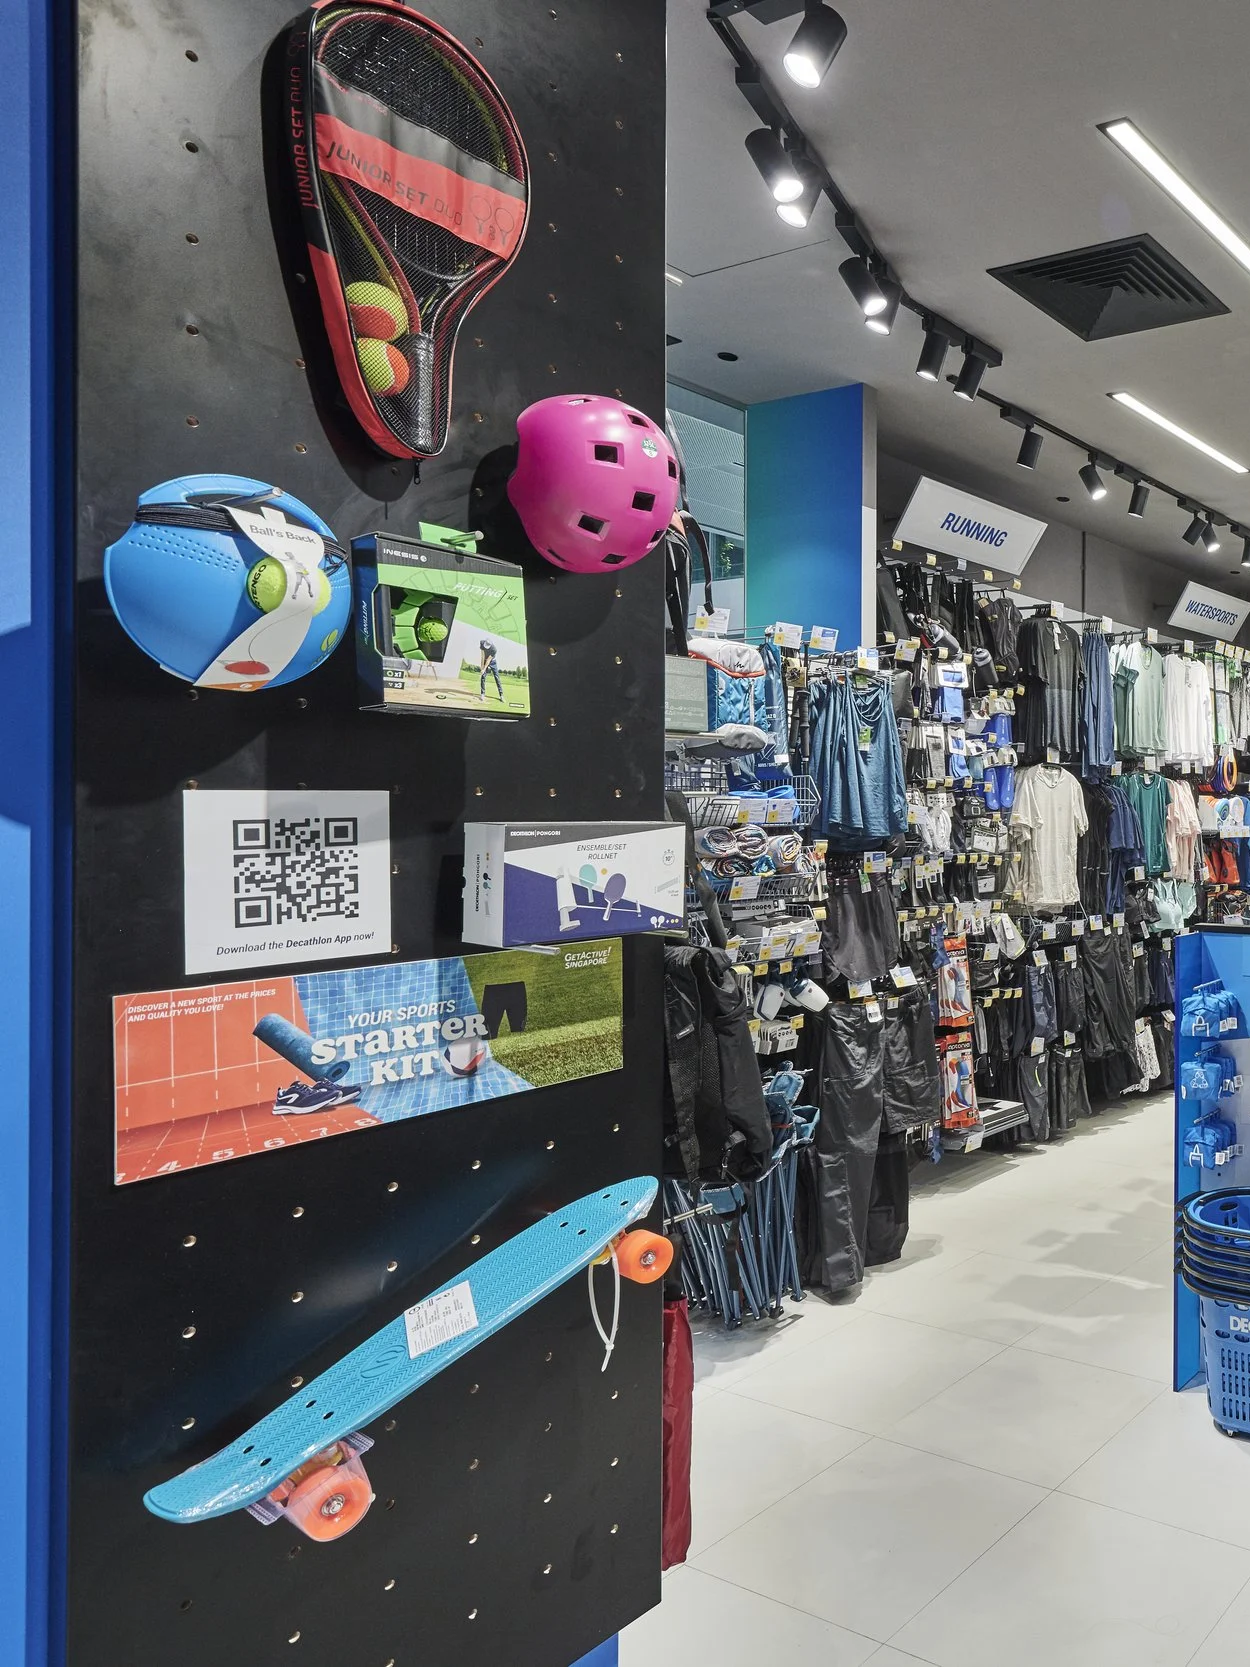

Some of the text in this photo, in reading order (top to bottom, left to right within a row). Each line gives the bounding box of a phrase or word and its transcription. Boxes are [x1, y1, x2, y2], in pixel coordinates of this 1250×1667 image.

[290, 106, 306, 138] SET
[294, 144, 320, 209] JUNIOR
[326, 141, 463, 226] JUNIOR SET DUO
[250, 524, 317, 544] Ball's Back
[939, 511, 1008, 549] RUNNING
[383, 548, 419, 560] INESIS
[453, 582, 505, 598] PUTTING
[1184, 599, 1239, 626] WATERSPORTS
[576, 842, 627, 852] ENSEMBLE/SET
[587, 852, 618, 860] ROLLNET
[216, 931, 375, 956] Download the Decathlon App now!
[564, 957, 608, 970] SINGAPORE
[127, 1003, 169, 1015] DISCOVER
[177, 999, 197, 1008] NEW
[197, 995, 223, 1005] SPORT
[234, 992, 249, 1000] THE
[250, 988, 277, 999] PRICES
[127, 1004, 224, 1023] AND QUALITY YOU LOVE!
[346, 999, 456, 1028] YOUR SPORTS
[369, 1048, 440, 1087] KIT
[156, 1160, 182, 1173] 4
[263, 1137, 286, 1149] 6
